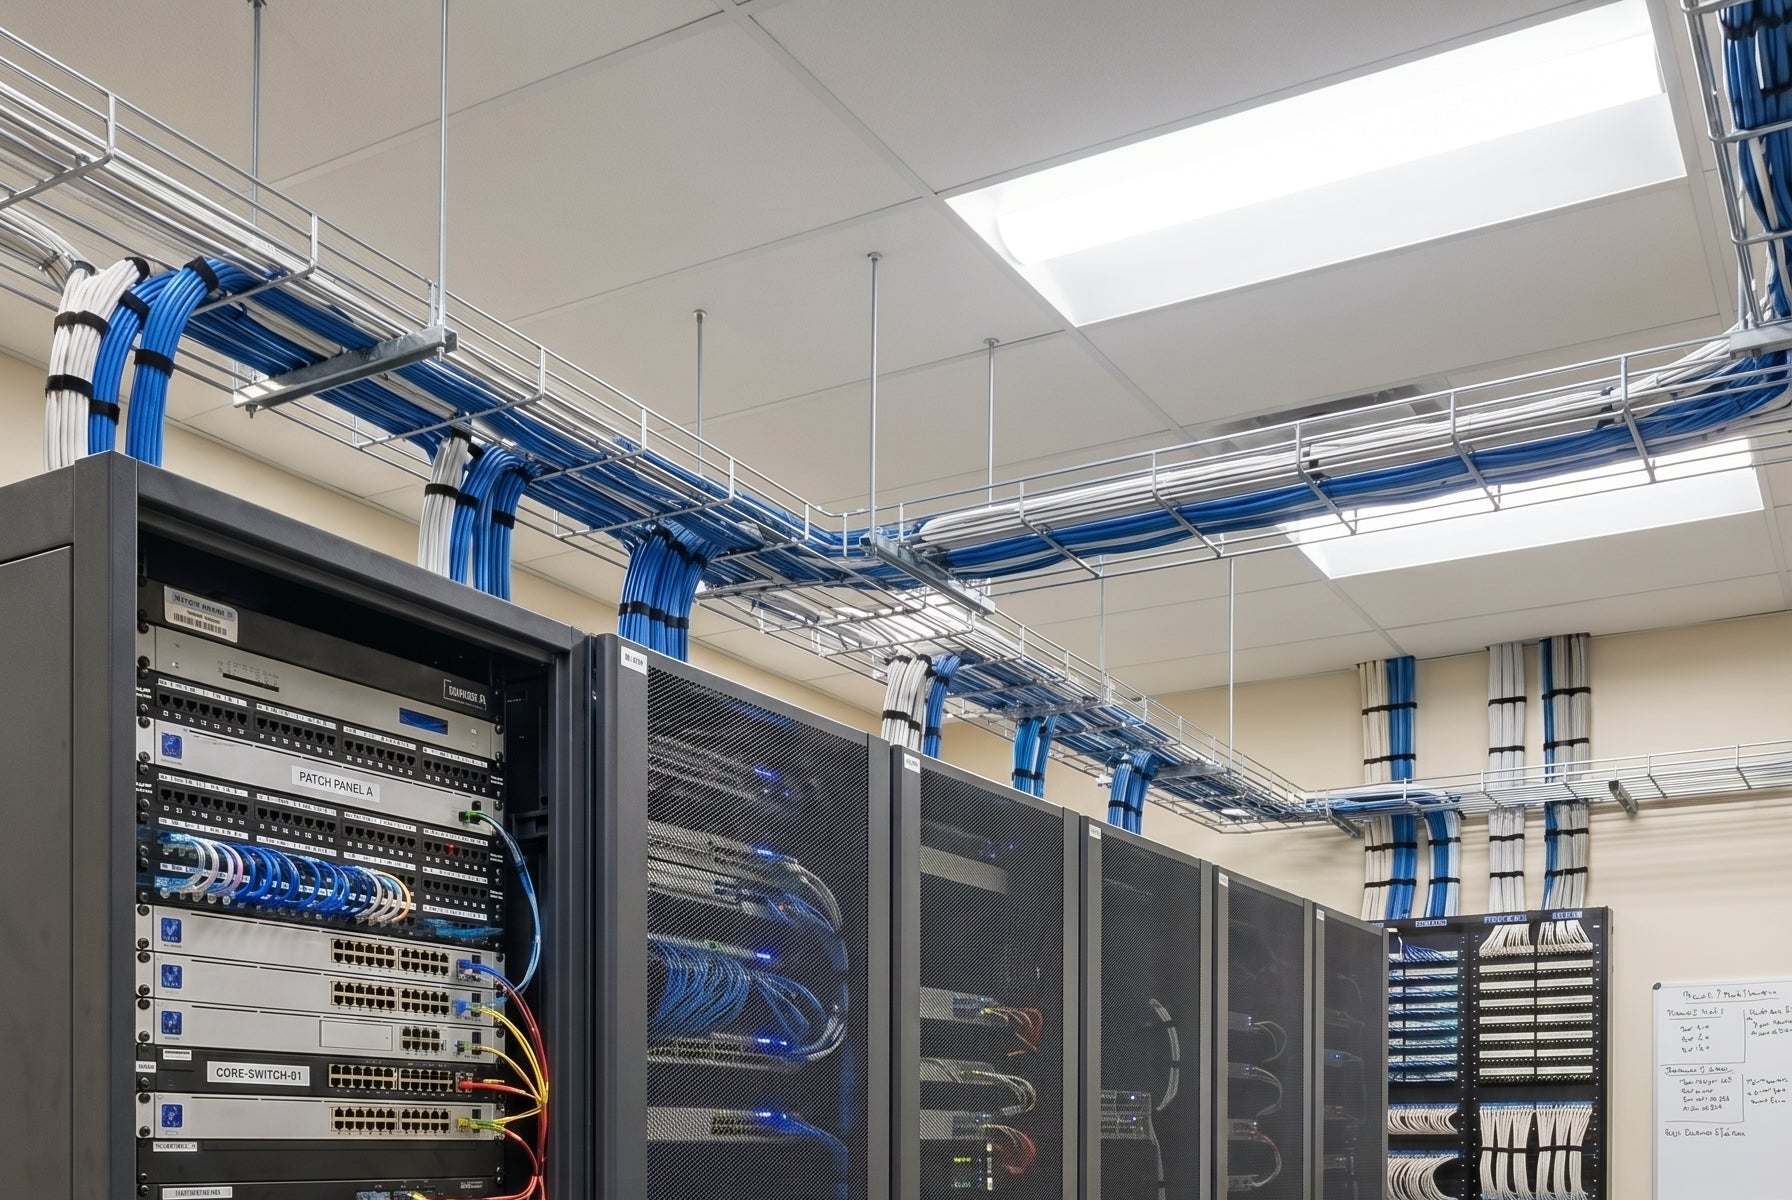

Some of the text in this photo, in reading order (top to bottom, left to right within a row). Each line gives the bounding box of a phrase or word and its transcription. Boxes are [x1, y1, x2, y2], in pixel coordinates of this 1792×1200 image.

[299, 771, 373, 796] PATCH PANEL A
[216, 1067, 301, 1081] CORE-SWITCH-01
